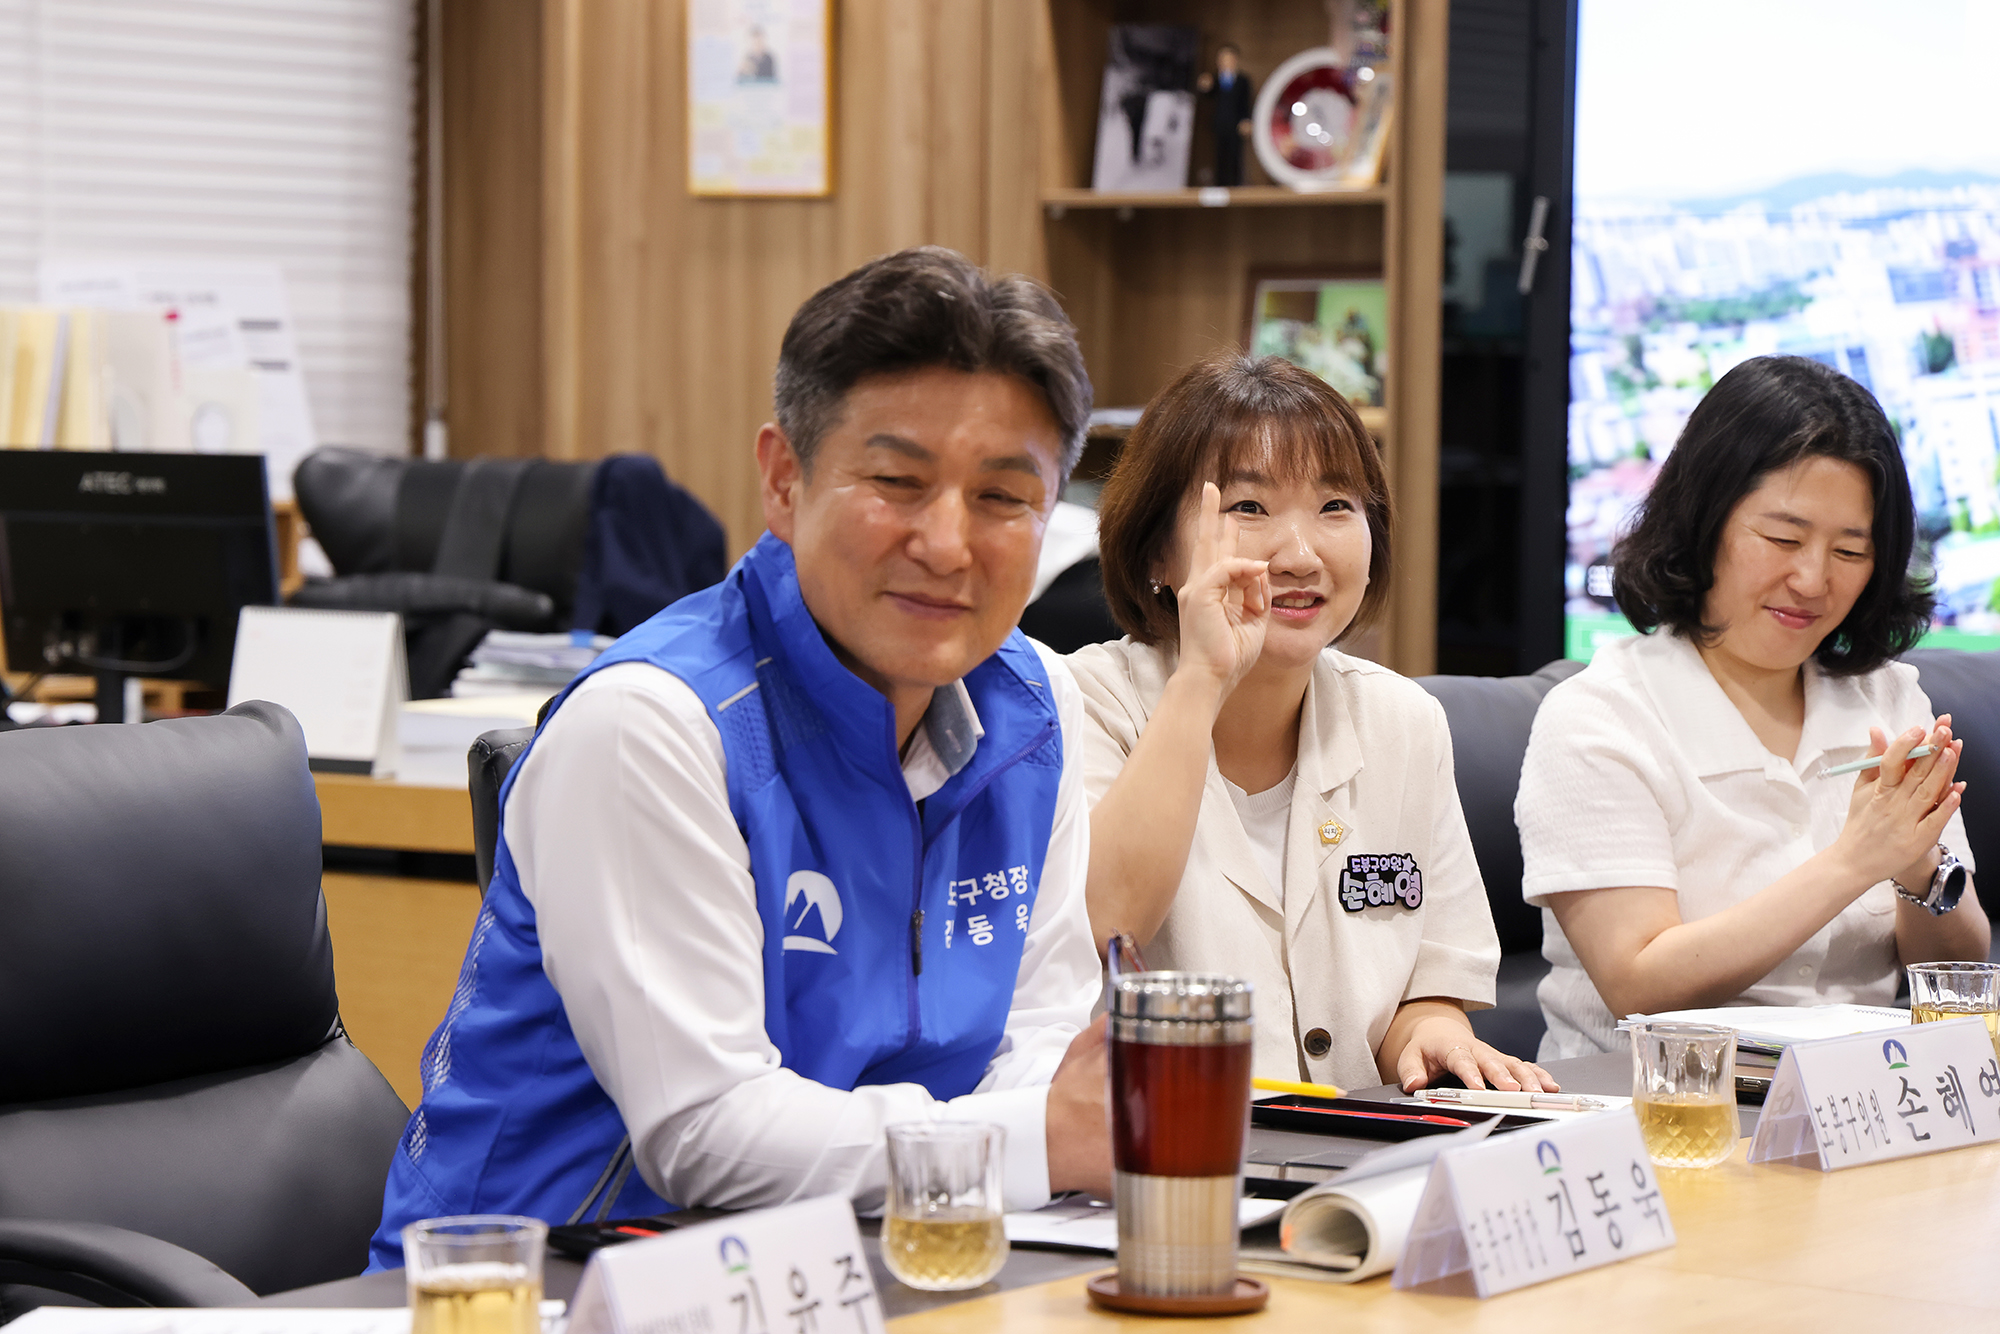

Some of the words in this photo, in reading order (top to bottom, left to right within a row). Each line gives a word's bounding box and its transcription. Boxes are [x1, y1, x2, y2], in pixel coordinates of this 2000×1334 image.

[1351, 856, 1402, 873] 도봉구의원
[947, 865, 1029, 907] 도구청장
[1342, 871, 1421, 910] 손혜영
[1814, 1088, 1891, 1154] 도봉구의원
[1547, 1160, 1666, 1260] 김동욱
